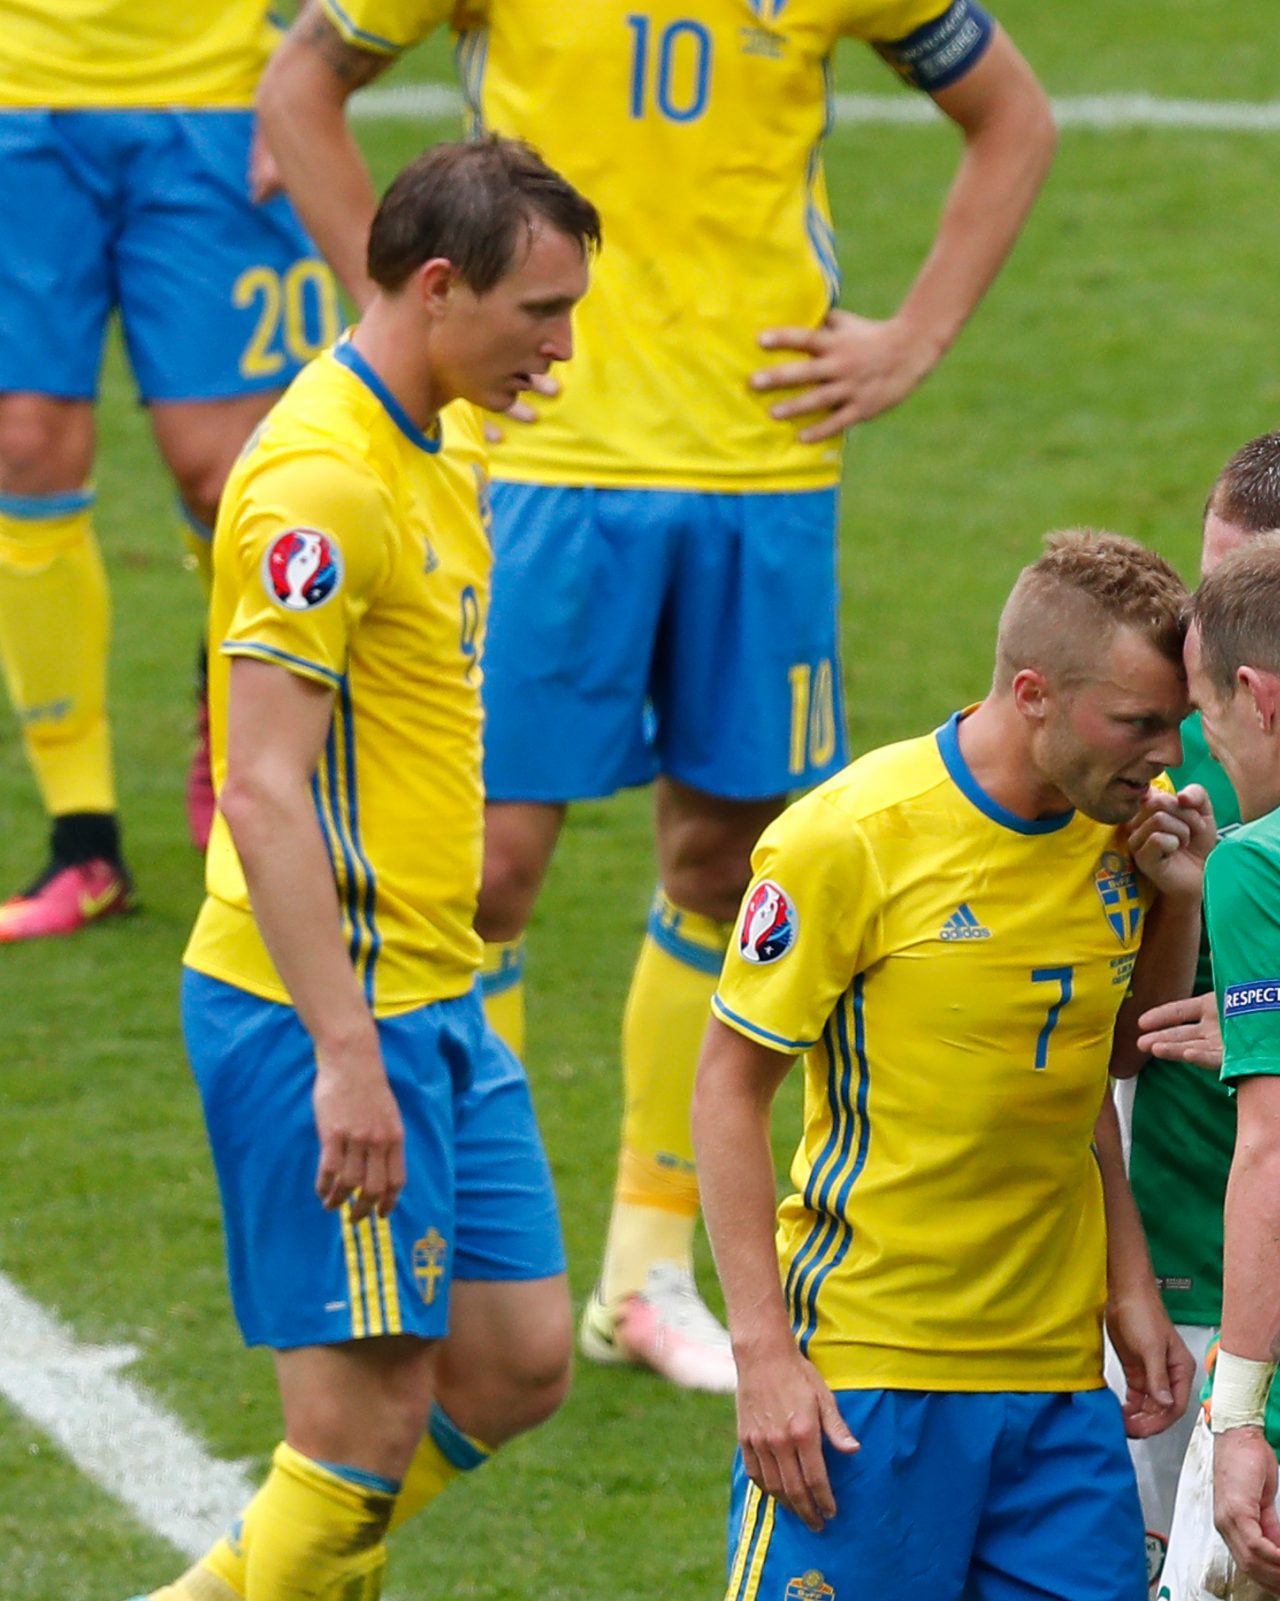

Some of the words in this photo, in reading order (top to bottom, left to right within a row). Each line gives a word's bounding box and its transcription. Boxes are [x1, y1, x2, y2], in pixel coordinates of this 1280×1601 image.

[627, 13, 712, 122] 10
[232, 259, 338, 379] 20
[788, 659, 836, 775] 10
[939, 926, 991, 940] adidas
[1031, 966, 1074, 1071] 7
